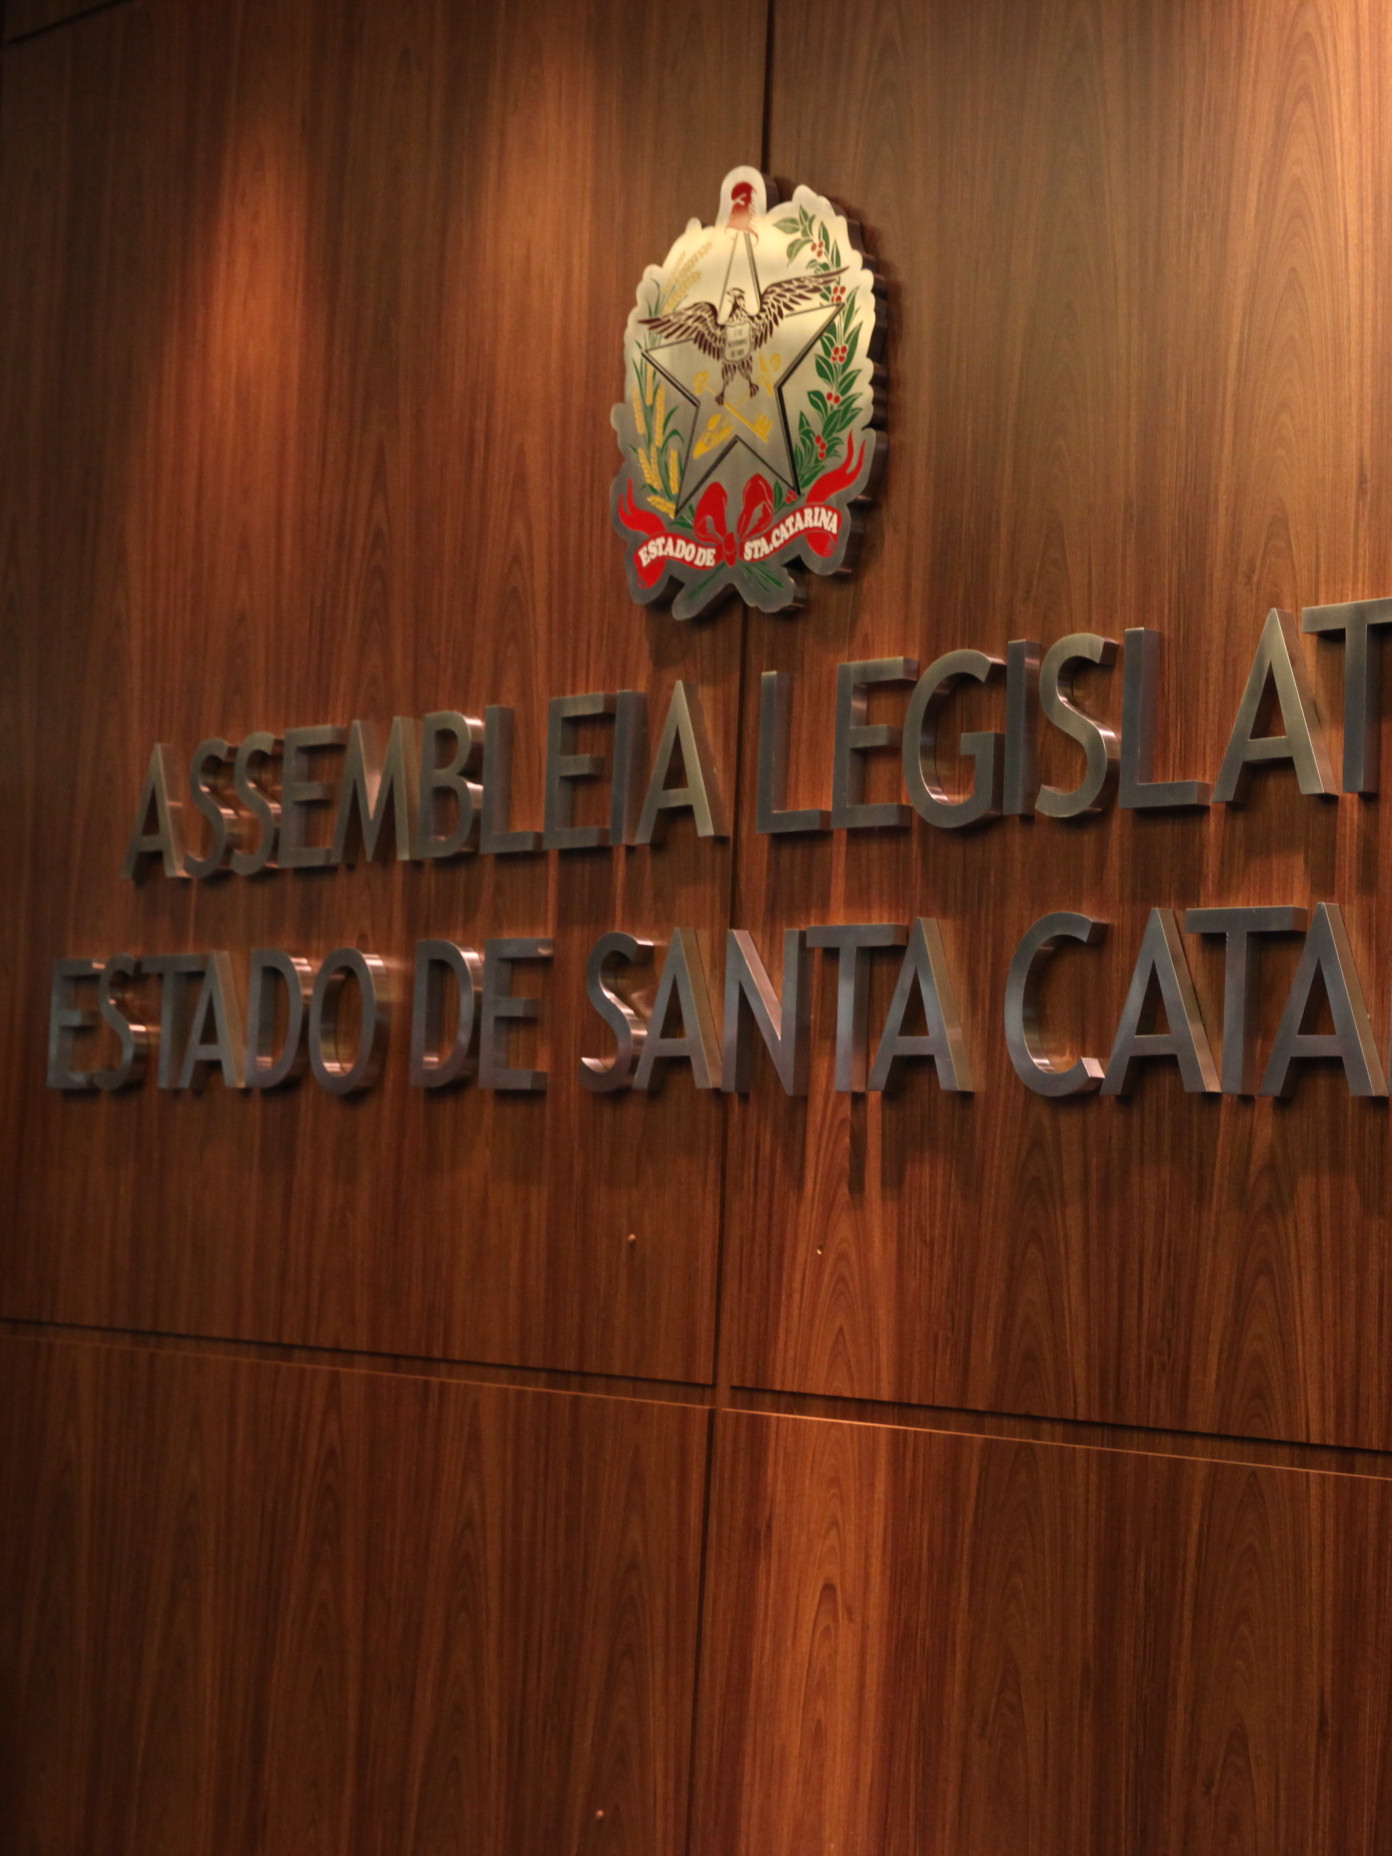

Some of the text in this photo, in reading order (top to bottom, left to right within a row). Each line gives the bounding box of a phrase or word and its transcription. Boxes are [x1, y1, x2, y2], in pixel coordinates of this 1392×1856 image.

[638, 536, 697, 567] ESTADO
[694, 546, 716, 567] DE
[771, 507, 838, 549] CATARINA
[122, 680, 726, 879] ASSEMBLEIA
[49, 947, 387, 1094] ESTADO
[411, 938, 554, 1089] DE
[579, 917, 973, 1095] SANTA
